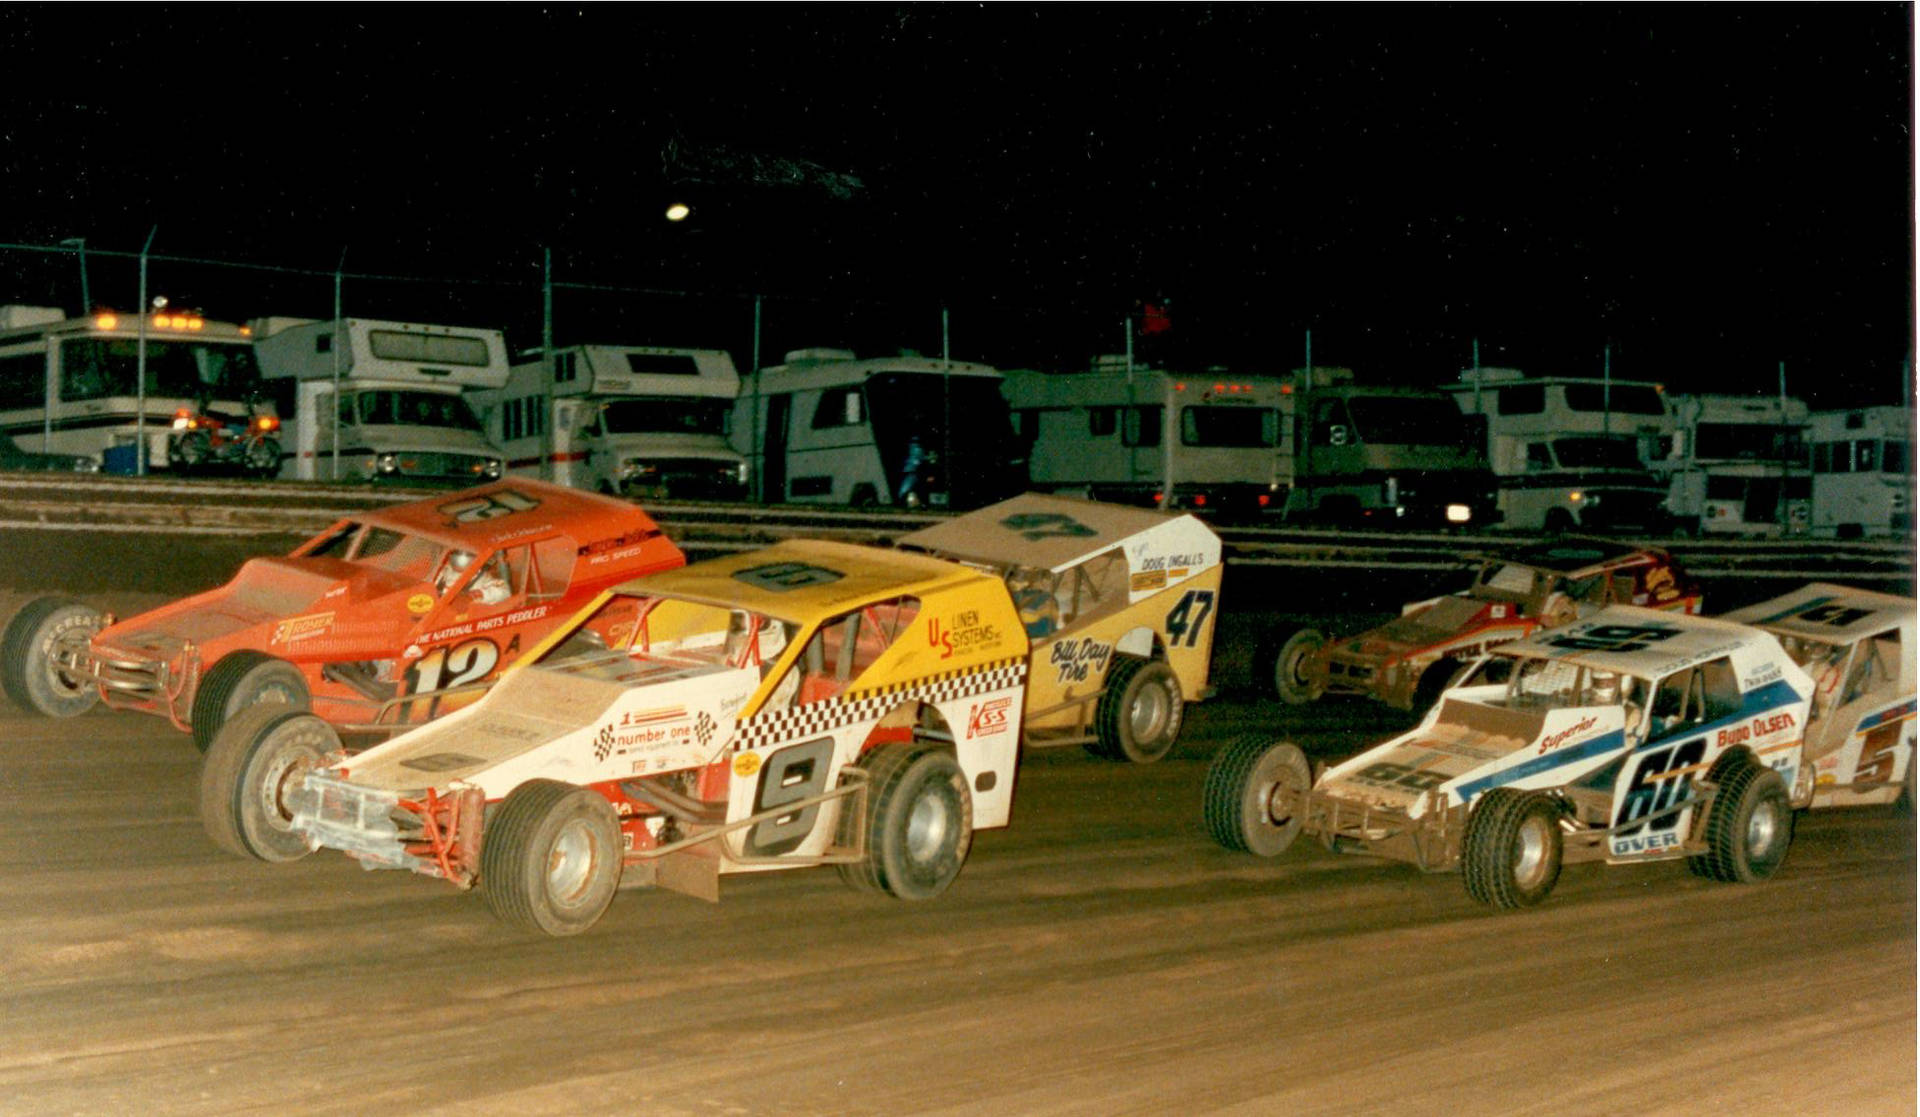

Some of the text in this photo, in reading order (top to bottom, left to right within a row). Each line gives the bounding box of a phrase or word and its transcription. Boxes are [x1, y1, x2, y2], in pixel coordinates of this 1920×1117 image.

[1142, 553, 1203, 571] DOUG INGALLS
[415, 606, 548, 645] THE NATIONAL PARTS PEDDLER
[952, 610, 979, 630] LINEN
[1165, 590, 1214, 648] 47
[953, 624, 994, 648] SYSTEMS
[1051, 637, 1111, 672] Bill Day
[401, 633, 521, 722] 12 A
[1059, 660, 1089, 684] Tire
[620, 712, 630, 726] 1
[1753, 713, 1796, 737] OLSEN
[617, 726, 691, 747] number one
[1539, 716, 1597, 755] Superior
[1852, 718, 1903, 794] 5
[1614, 737, 1708, 838] 60
[1614, 833, 1679, 854] OVER
